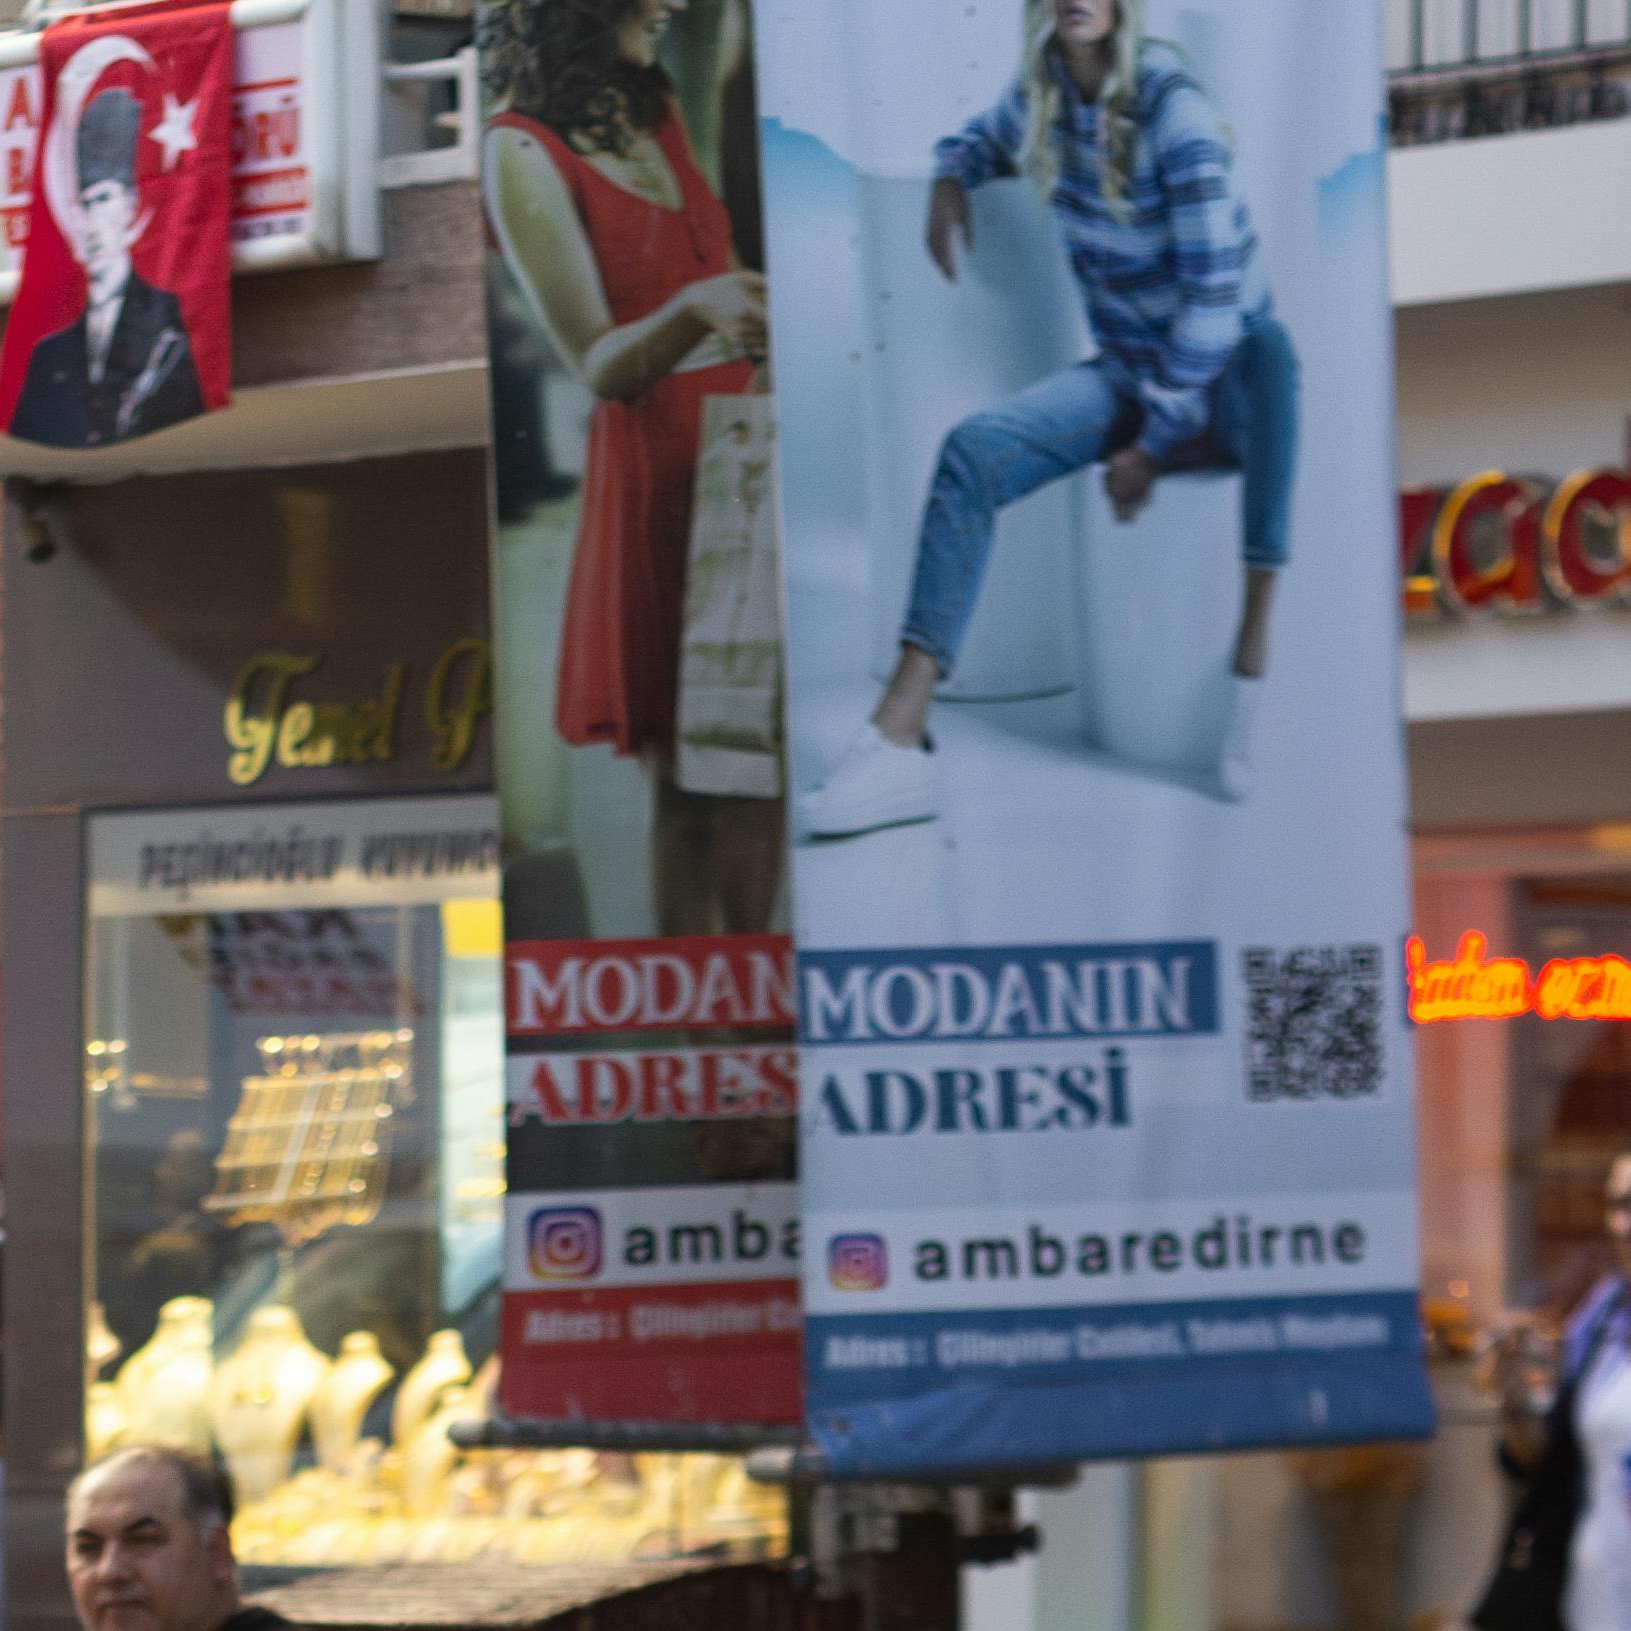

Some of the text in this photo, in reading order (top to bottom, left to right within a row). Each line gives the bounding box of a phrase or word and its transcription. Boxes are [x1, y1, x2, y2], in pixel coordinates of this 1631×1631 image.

[513, 951, 799, 1029] MODAN
[802, 956, 1194, 1040] MODANIN
[508, 1050, 797, 1127] ADRES
[806, 1046, 1133, 1137] ADRESİ
[914, 1214, 1366, 1281] ambaredirne
